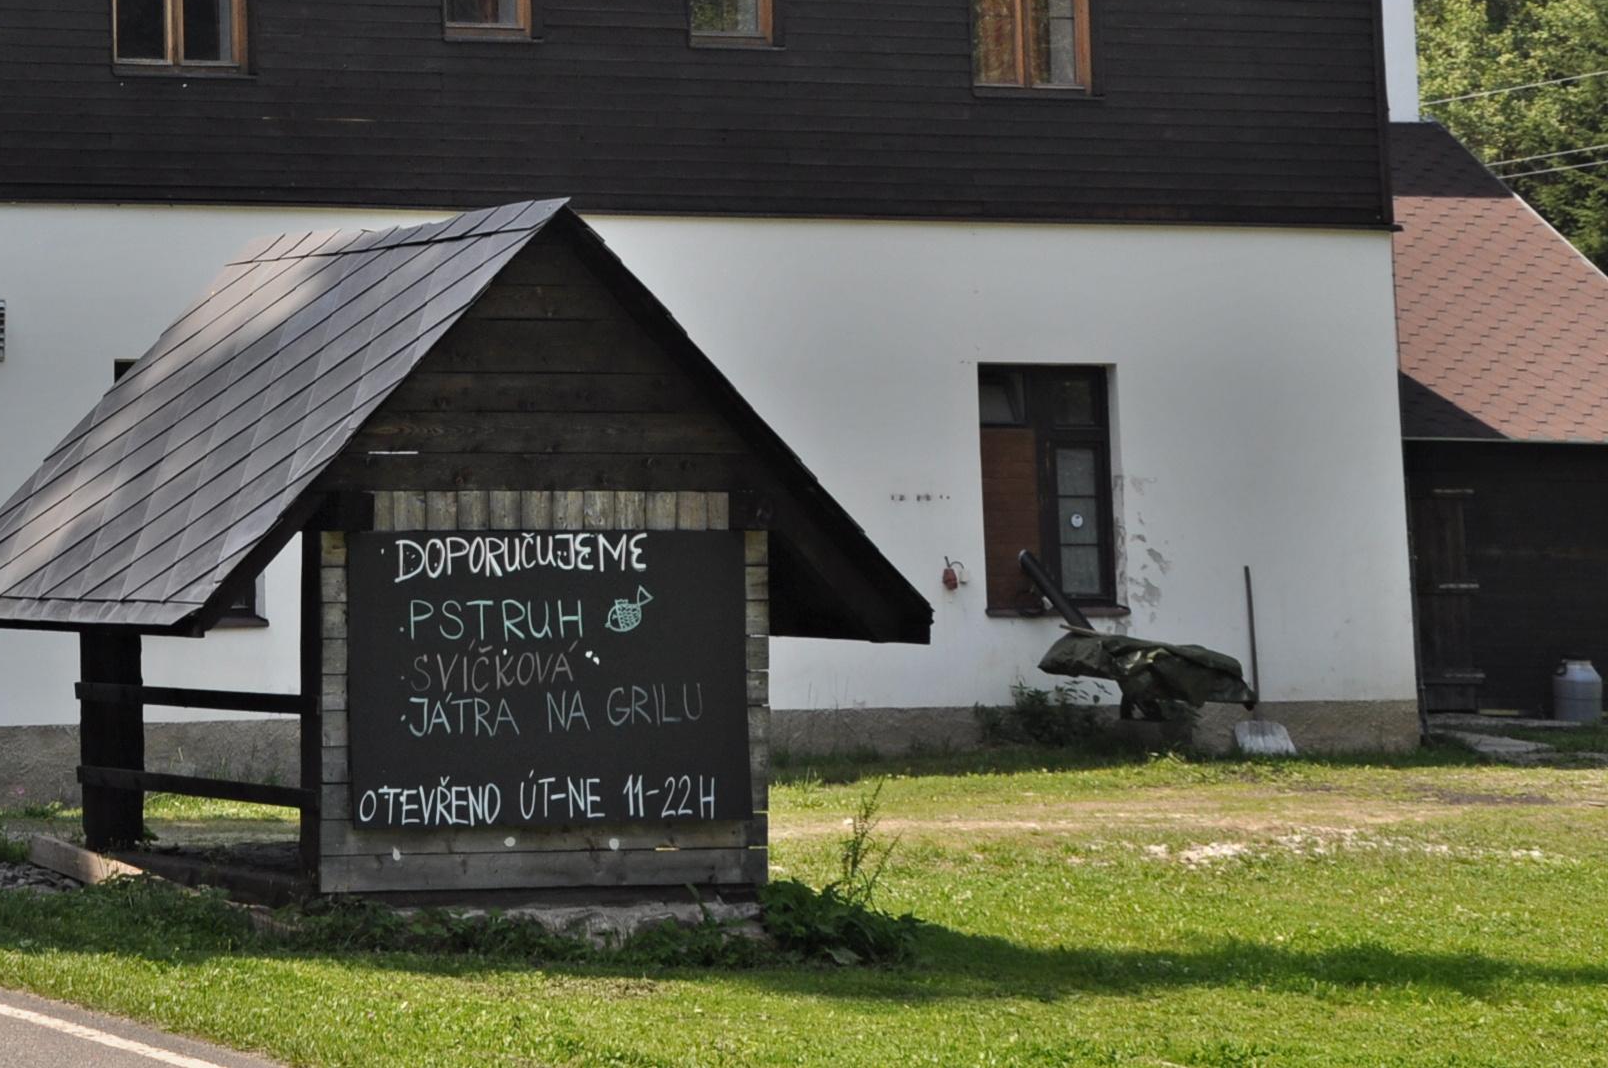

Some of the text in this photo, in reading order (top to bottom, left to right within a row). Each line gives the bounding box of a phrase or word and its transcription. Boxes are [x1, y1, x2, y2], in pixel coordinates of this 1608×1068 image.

[394, 532, 648, 583] DOPORUČUJEME
[410, 599, 583, 641] PSTRUH
[410, 638, 578, 693] SVÍČKOVÁ
[409, 683, 703, 736] JÁTRA NA GRILU
[359, 776, 501, 826] OTEVŘENO
[519, 769, 606, 820] ÚT-NE
